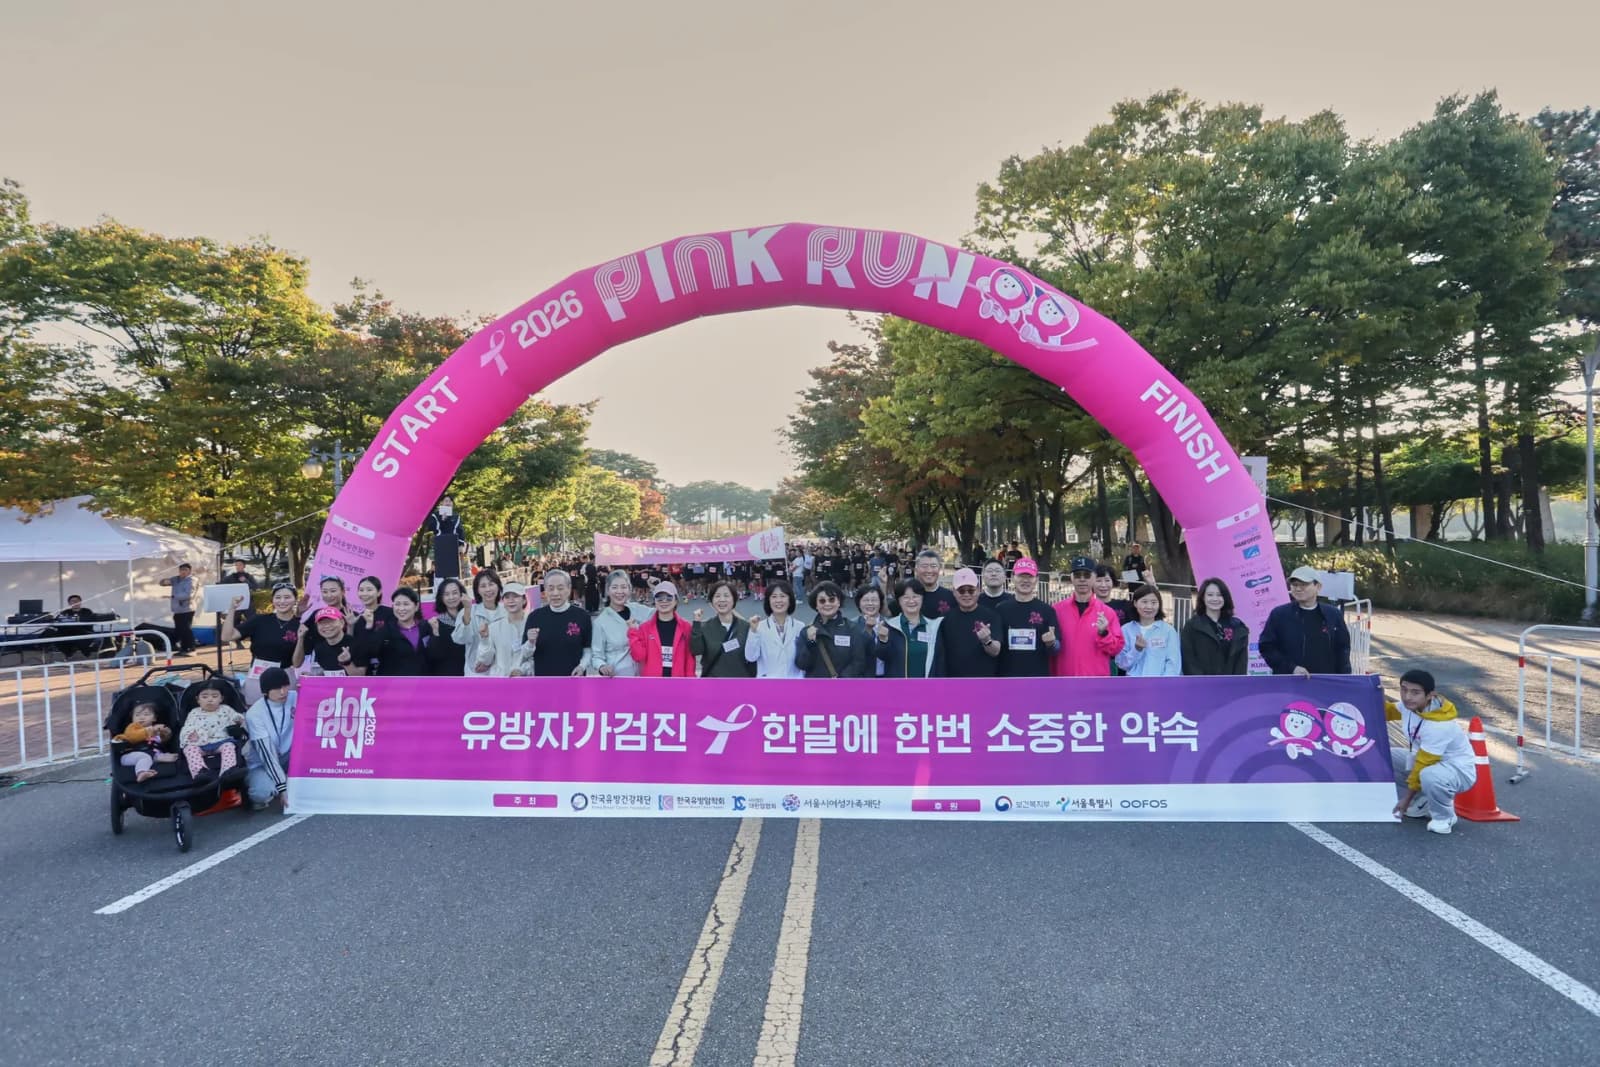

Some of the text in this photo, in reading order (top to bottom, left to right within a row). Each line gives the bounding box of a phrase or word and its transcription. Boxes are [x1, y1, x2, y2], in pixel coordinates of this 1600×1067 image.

[510, 290, 584, 348] 2026
[806, 227, 976, 309] RUN
[371, 375, 458, 478] START
[1140, 379, 1231, 483] FINISH
[364, 718, 377, 746] 2026
[460, 711, 1199, 754] 유방자가검진 한달에 한번 소중한 약속
[590, 794, 651, 806] 한국유방건강재단
[803, 798, 881, 809] 서울시여성가족재단
[1071, 797, 1113, 809] 서울특별시
[1119, 799, 1168, 809] OOFOS
